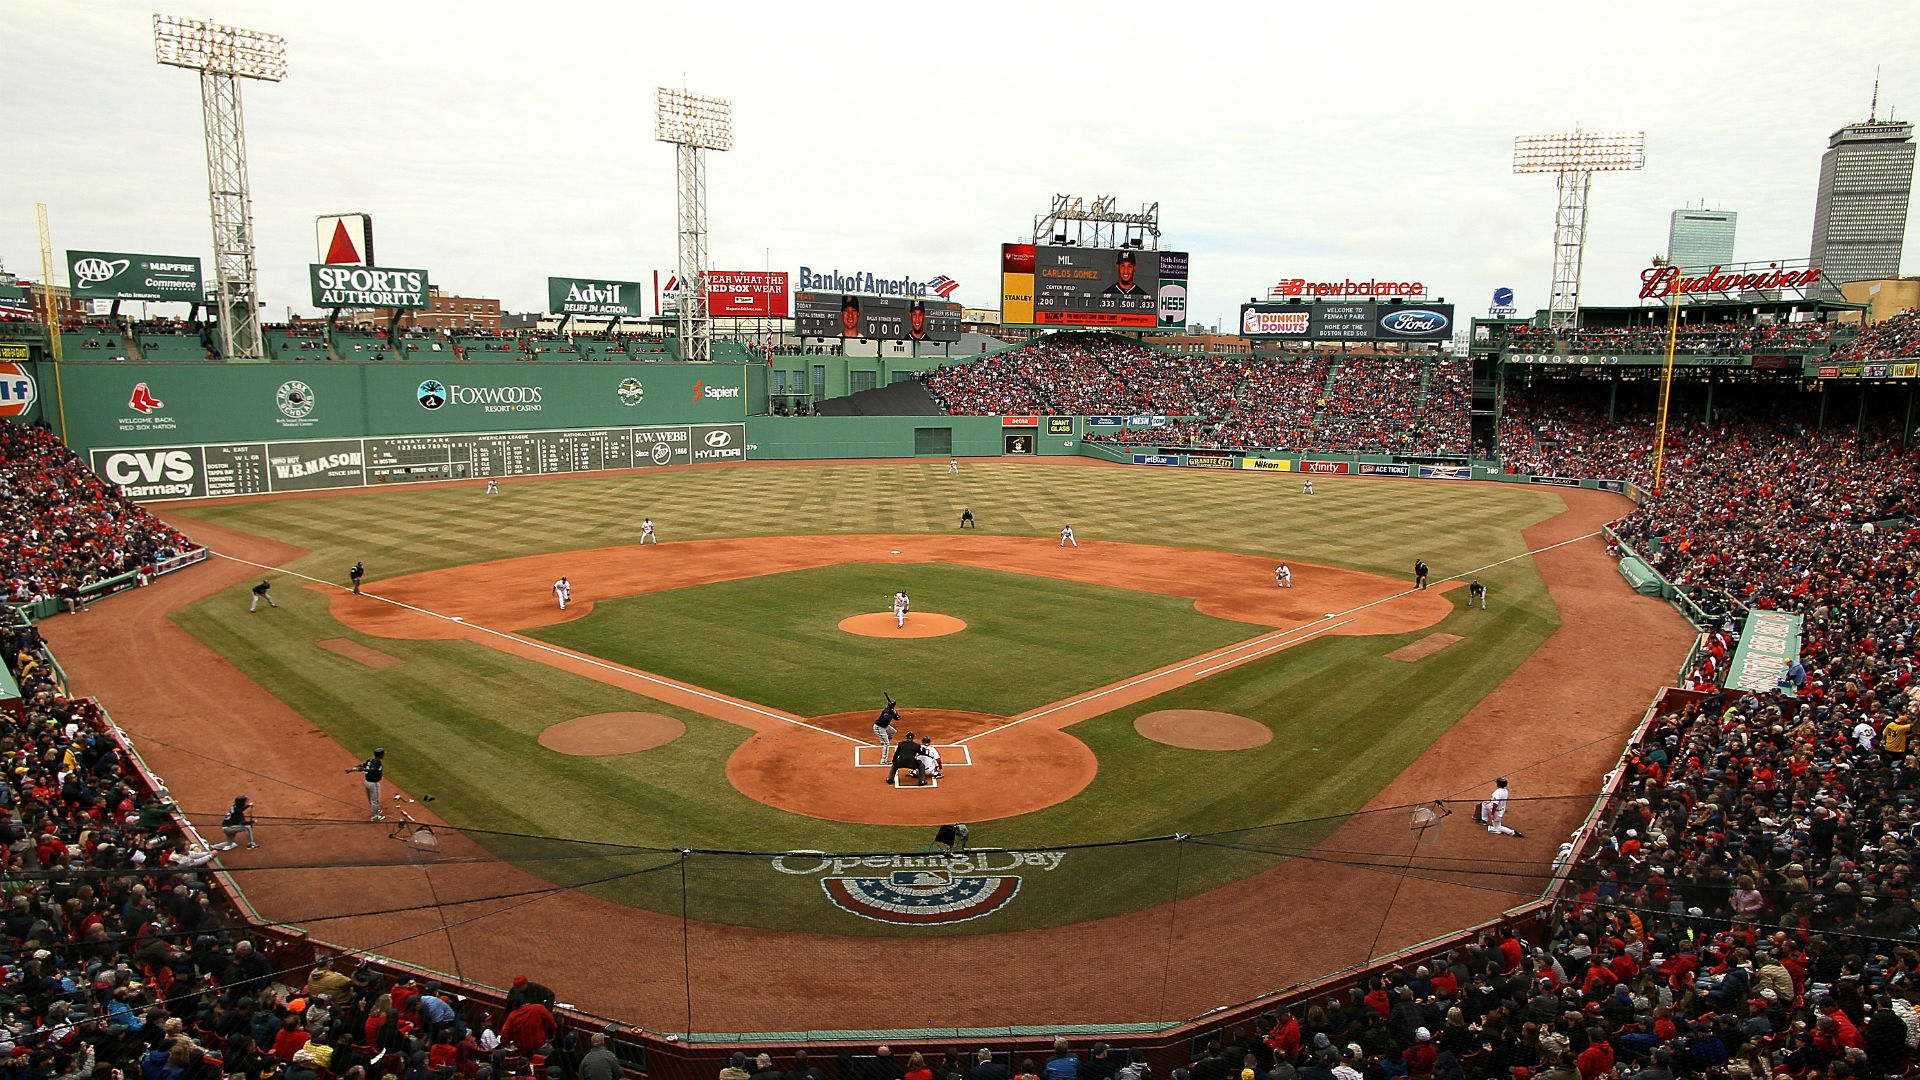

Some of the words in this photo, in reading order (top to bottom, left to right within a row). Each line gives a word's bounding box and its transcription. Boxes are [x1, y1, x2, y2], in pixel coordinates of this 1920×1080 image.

[1035, 193, 1086, 240] John
[1086, 195, 1161, 237] Hancock
[1058, 255, 1073, 266] MIL
[79, 260, 110, 280] AAA
[150, 262, 196, 272] MAPFRE
[318, 267, 422, 292] SPORTS
[1042, 269, 1071, 278] CARLOS
[1074, 270, 1098, 279] GOMEZ
[146, 278, 196, 289] Commerce
[734, 276, 763, 284] WHAT
[766, 276, 784, 285] THE
[1639, 262, 1823, 299] Budweiser
[565, 282, 622, 304] Advil
[726, 284, 750, 293] SOX
[754, 285, 782, 294] WEAR
[564, 304, 588, 312] RELIEF
[589, 304, 598, 312] IN
[600, 305, 628, 314] ACTION
[1098, 300, 1116, 308] .333
[1119, 300, 1135, 308] .500
[1139, 301, 1154, 309] .833
[1161, 297, 1185, 310] HESS
[1261, 314, 1308, 324] DUNKIN'
[1394, 313, 1434, 330] Ford
[869, 323, 875, 334] 0
[882, 324, 888, 334] 0
[894, 324, 900, 336] 0
[1261, 322, 1305, 332] DONUTS
[450, 385, 542, 404] FOXWOODS
[704, 385, 738, 400] Sapient
[516, 404, 542, 412] CASINO
[656, 432, 687, 442] WEBB
[695, 448, 741, 459] HYUNDAI
[1145, 456, 1167, 464] jetBlue
[1219, 458, 1233, 467] CITY
[1254, 461, 1279, 469] Nikon
[106, 451, 194, 484] CVS
[122, 484, 193, 497] harmacy
[772, 850, 974, 875] Opening
[964, 848, 1066, 872] Day
